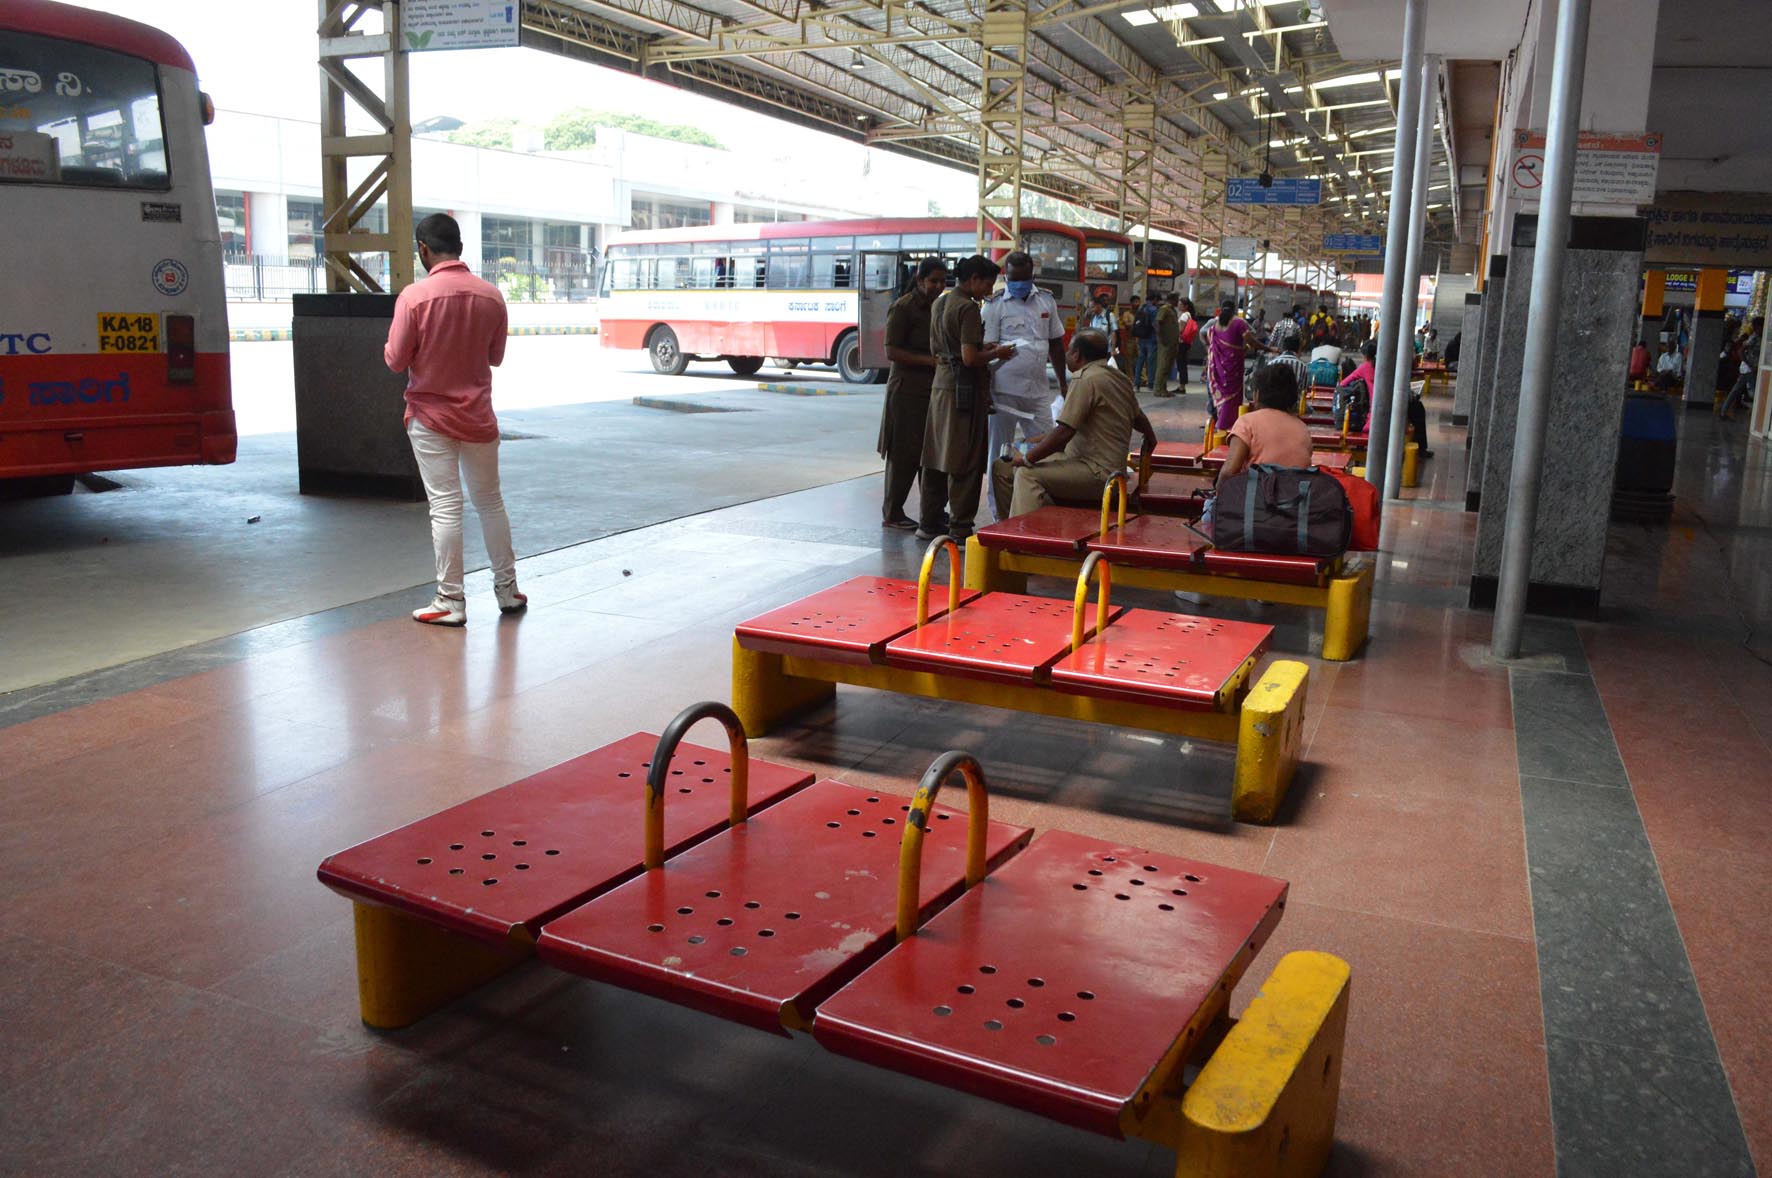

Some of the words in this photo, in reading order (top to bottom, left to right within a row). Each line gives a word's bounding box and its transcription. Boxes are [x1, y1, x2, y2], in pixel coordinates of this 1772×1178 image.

[1228, 184, 1242, 197] 02
[1666, 273, 1688, 282] LODGE
[100, 335, 158, 351] F-0821
[29, 371, 131, 406] ಸಾರಿಗೆ
